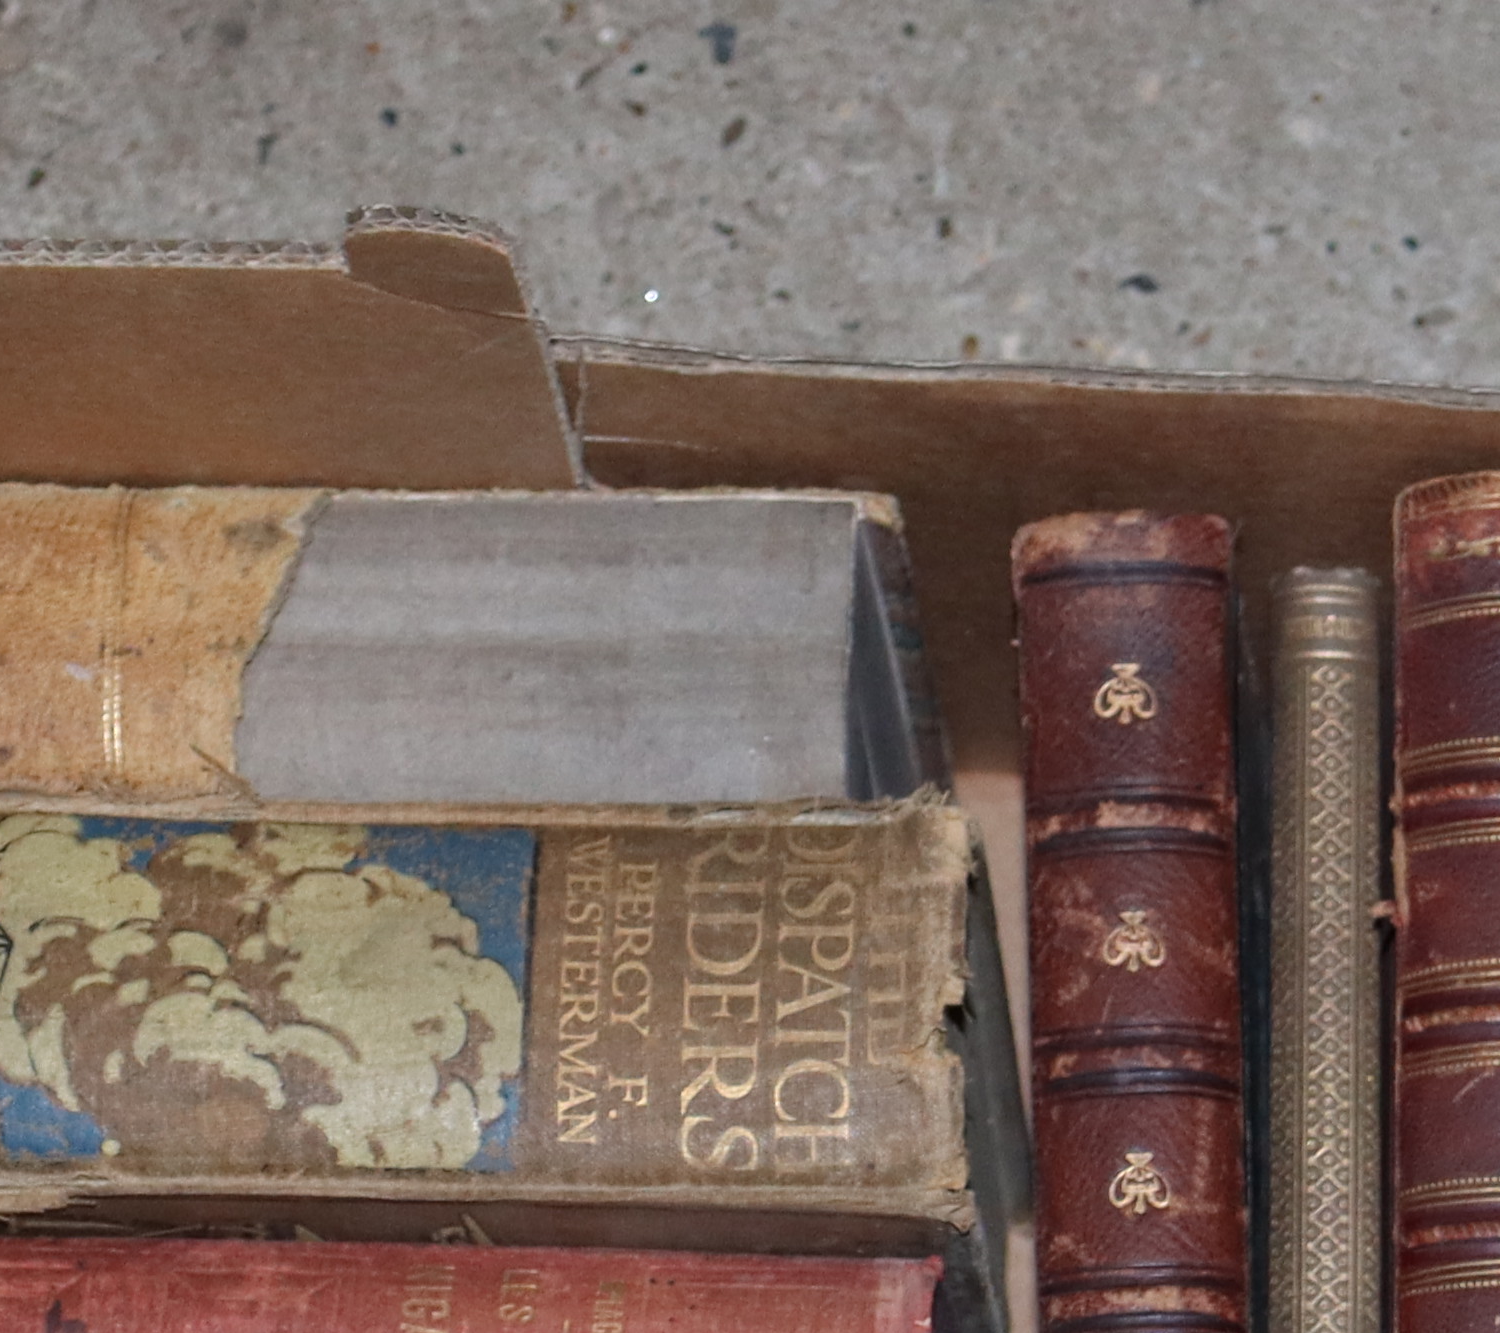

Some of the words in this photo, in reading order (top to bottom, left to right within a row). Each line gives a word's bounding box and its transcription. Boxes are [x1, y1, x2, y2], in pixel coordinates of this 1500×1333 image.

[556, 835, 612, 1146] WESTERMAN
[607, 1074, 650, 1121] F.
[608, 860, 659, 1038] PERCY
[680, 826, 771, 1171] RIDERS
[774, 825, 861, 1177] DISPATCH
